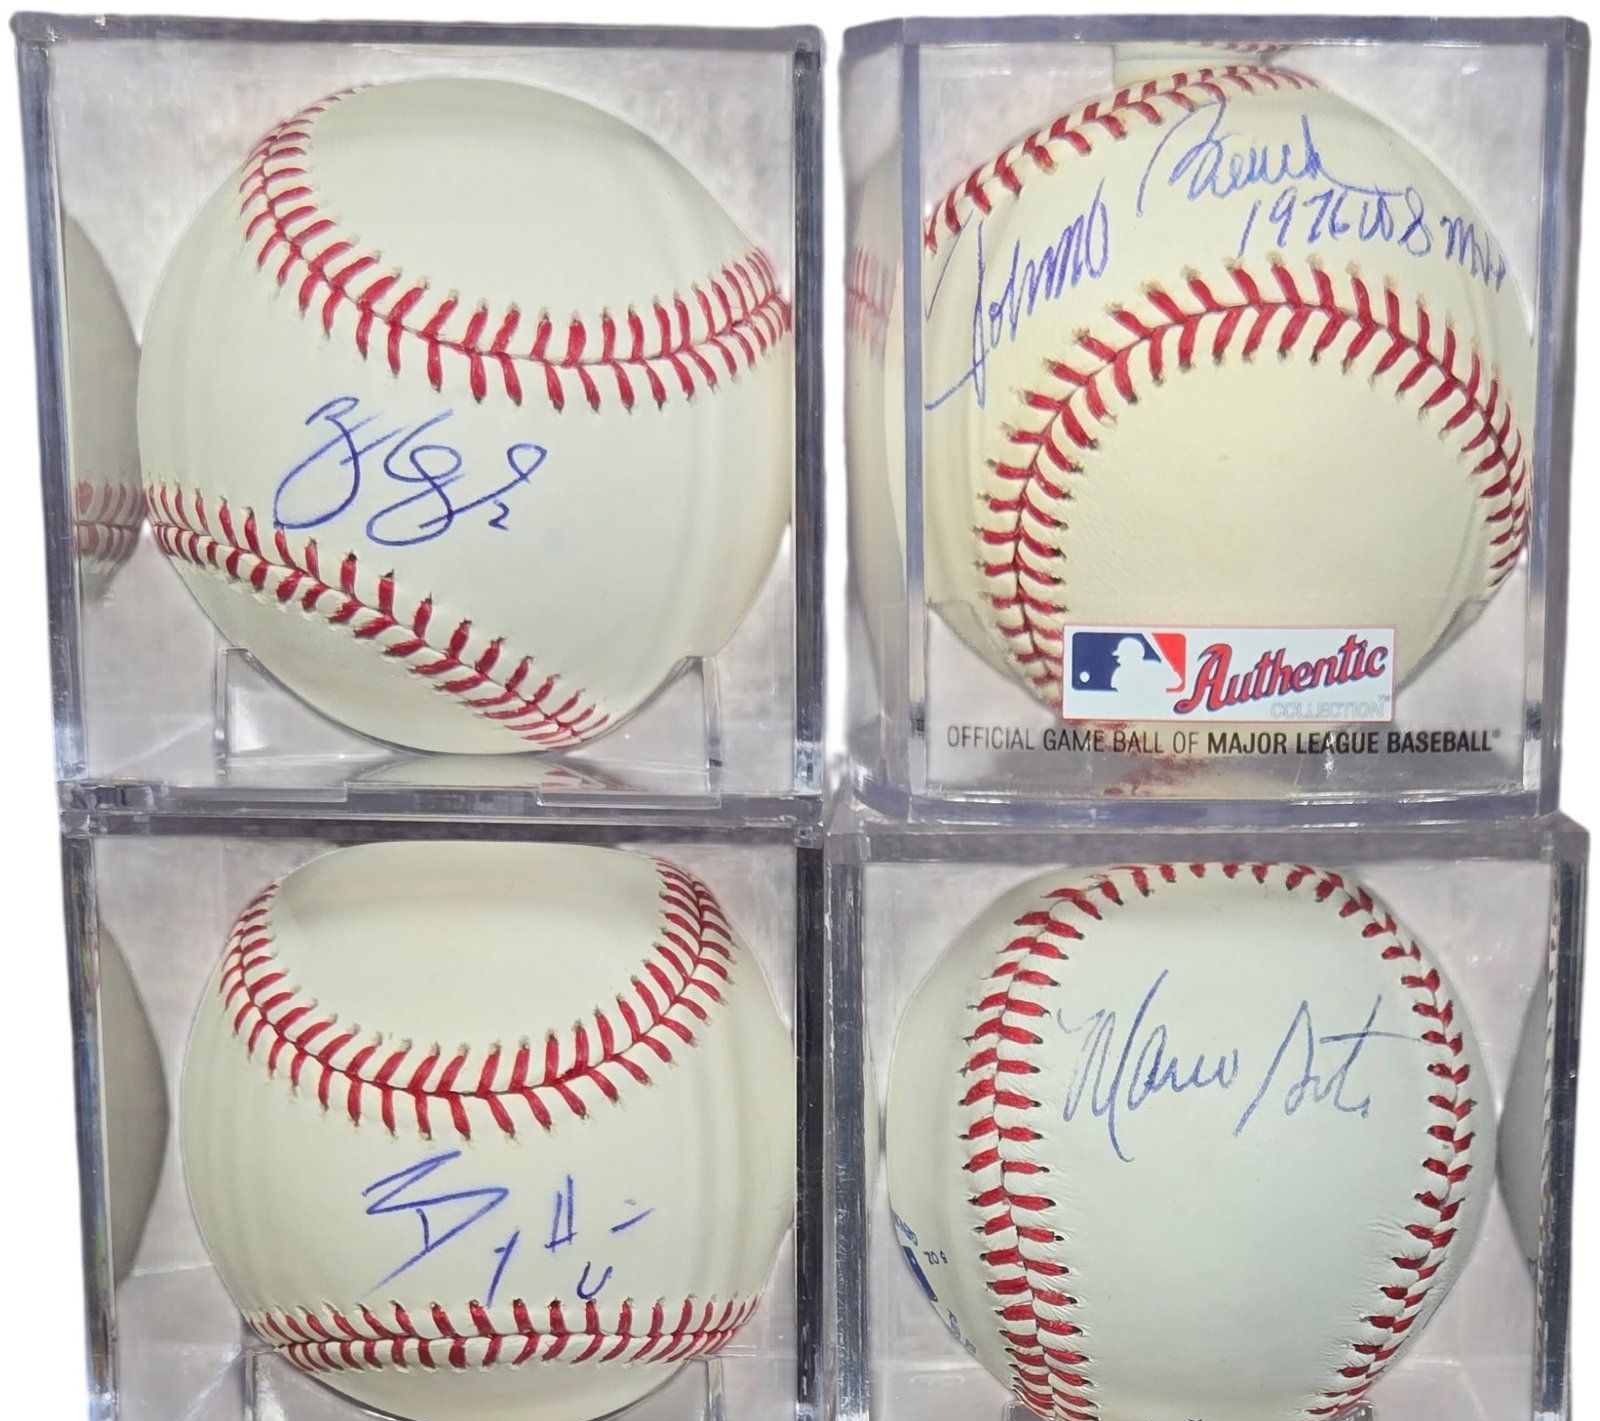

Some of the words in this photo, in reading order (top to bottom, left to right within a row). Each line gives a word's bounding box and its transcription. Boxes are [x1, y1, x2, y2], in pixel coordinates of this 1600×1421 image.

[1237, 188, 1352, 257] 1976
[1172, 633, 1389, 715] Authentic
[946, 725, 1036, 750] OFFICIAL
[1042, 728, 1105, 751] GAME
[1112, 730, 1165, 754] BALL
[1172, 730, 1200, 754] OF
[1207, 731, 1288, 754] MAJOR
[1296, 730, 1379, 754] LEAGUE
